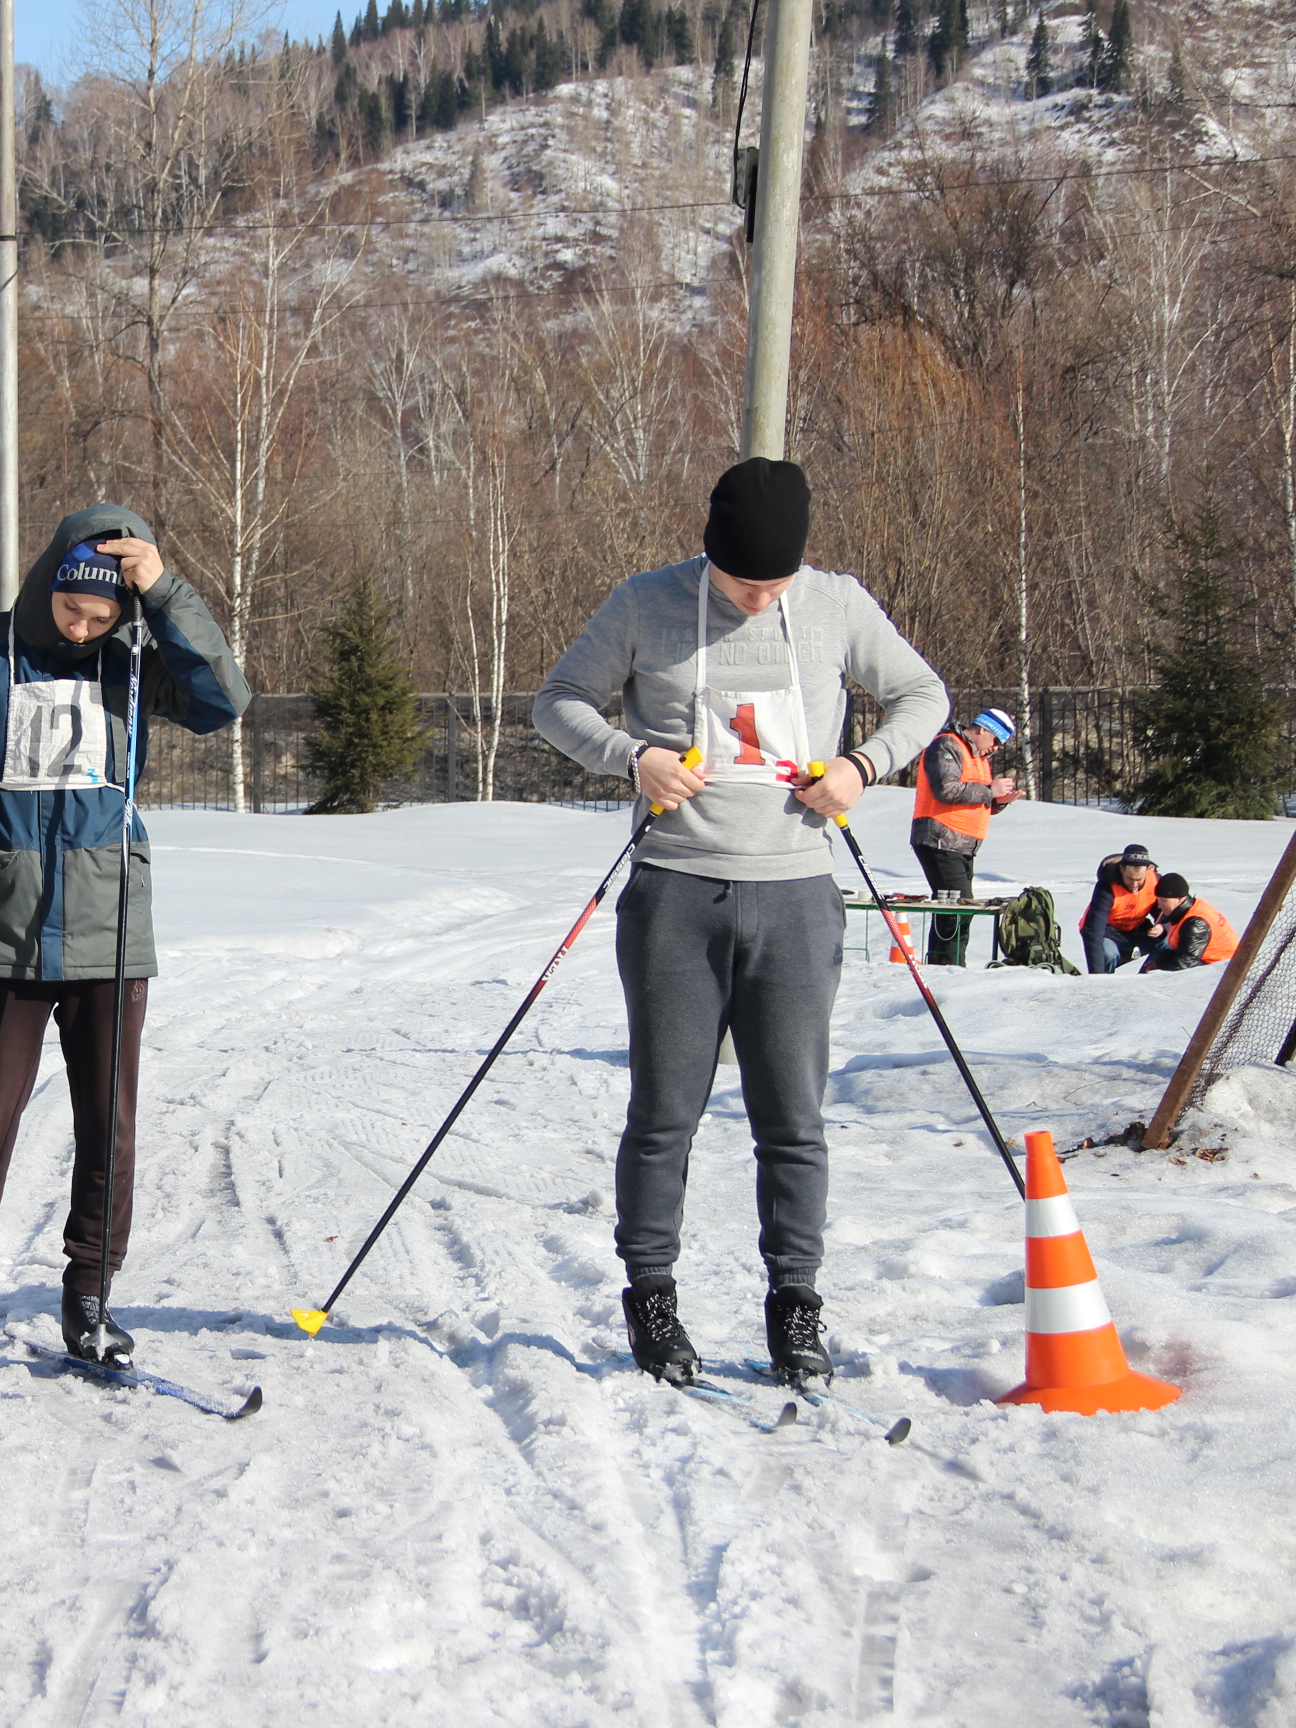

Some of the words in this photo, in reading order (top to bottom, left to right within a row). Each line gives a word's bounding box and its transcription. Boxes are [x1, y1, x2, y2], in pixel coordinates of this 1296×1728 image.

[718, 643, 747, 666] NO
[28, 703, 83, 778] 12
[729, 702, 766, 765] 1
[602, 843, 636, 892] Classic
